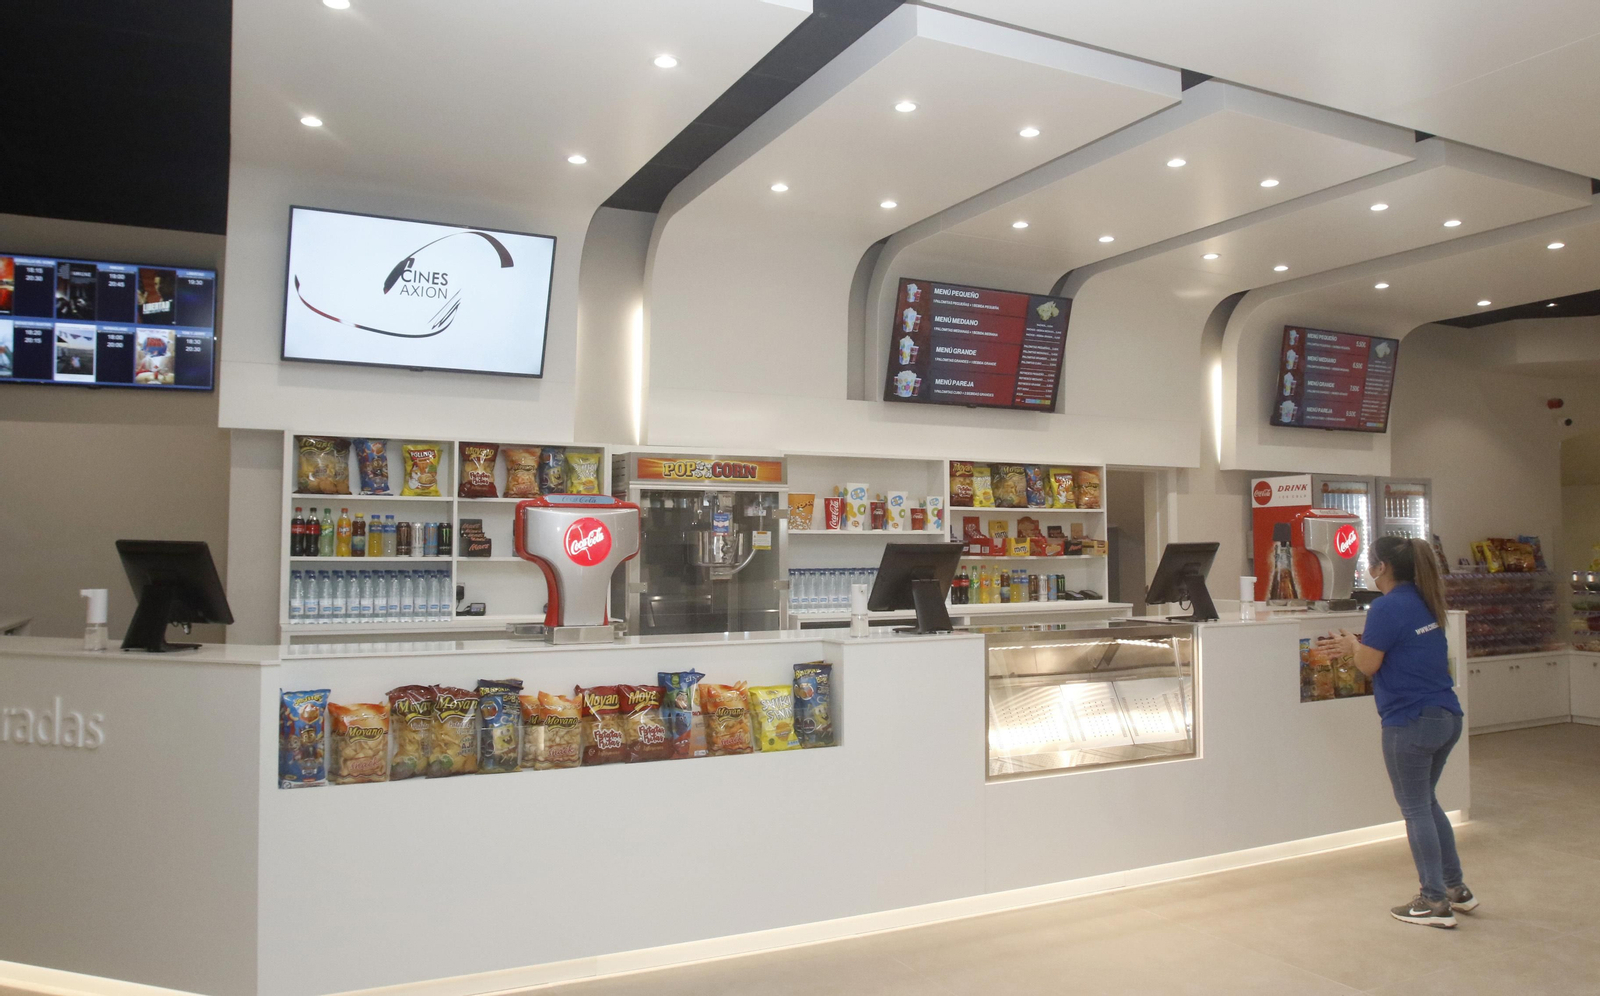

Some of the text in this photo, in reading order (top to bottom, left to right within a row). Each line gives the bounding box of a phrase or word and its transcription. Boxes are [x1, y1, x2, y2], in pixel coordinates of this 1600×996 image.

[400, 269, 448, 286] CINES
[400, 284, 448, 299] AXION
[952, 290, 979, 299] PEQUEÑO
[664, 460, 758, 478] POP CORN
[1254, 488, 1271, 498] Coca-Cola
[1277, 484, 1308, 492] DRINK
[829, 500, 839, 529] Coca-Cola
[570, 527, 604, 554] Coca-Cola
[1341, 530, 1356, 553] Coca-Cola
